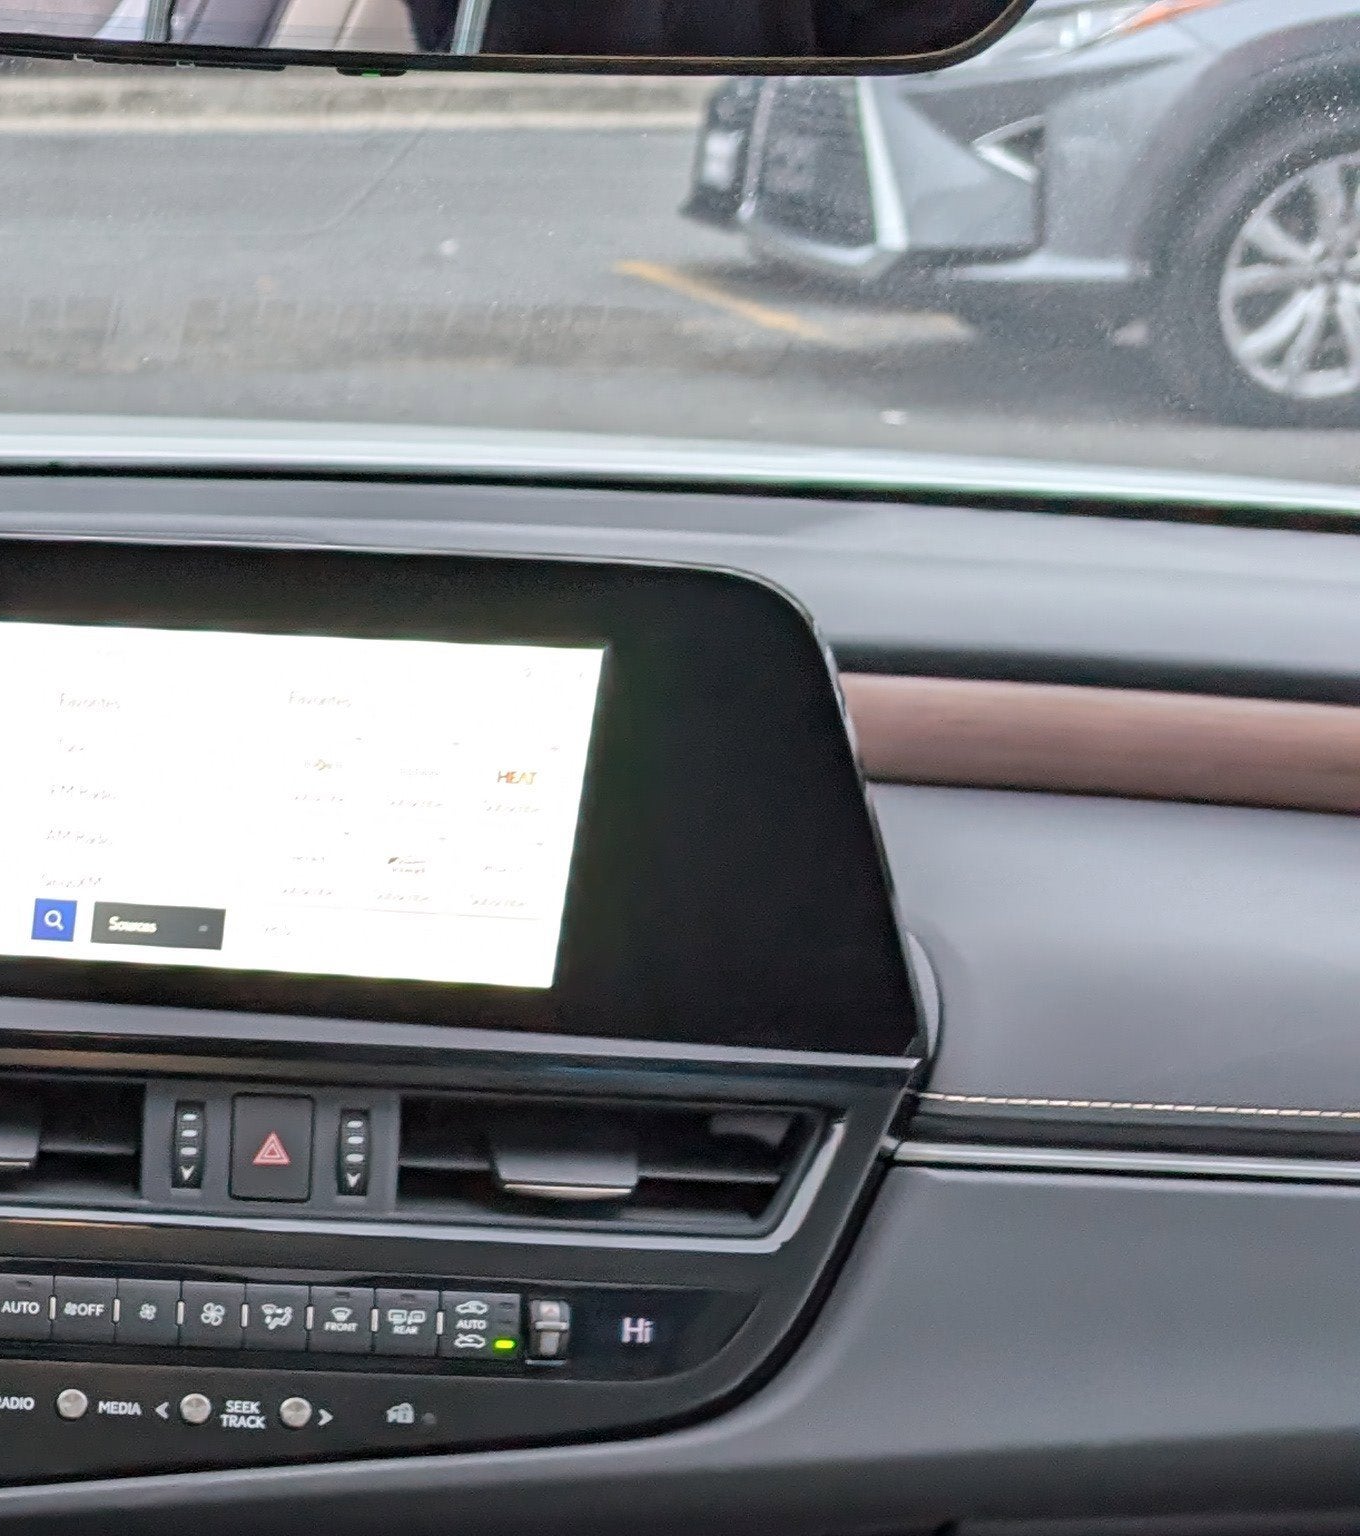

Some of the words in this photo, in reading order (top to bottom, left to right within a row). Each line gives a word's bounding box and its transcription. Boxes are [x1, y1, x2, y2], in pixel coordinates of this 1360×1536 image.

[0, 1300, 41, 1315] AUTO
[78, 1302, 106, 1317] OFF
[323, 1322, 359, 1334] FRONT
[392, 1324, 419, 1336] REAR
[455, 1319, 487, 1331] AUTO
[621, 1316, 656, 1345] Hi
[97, 1400, 143, 1416] MEDIA
[225, 1399, 262, 1414] SEEK
[219, 1414, 267, 1429] TRACK
